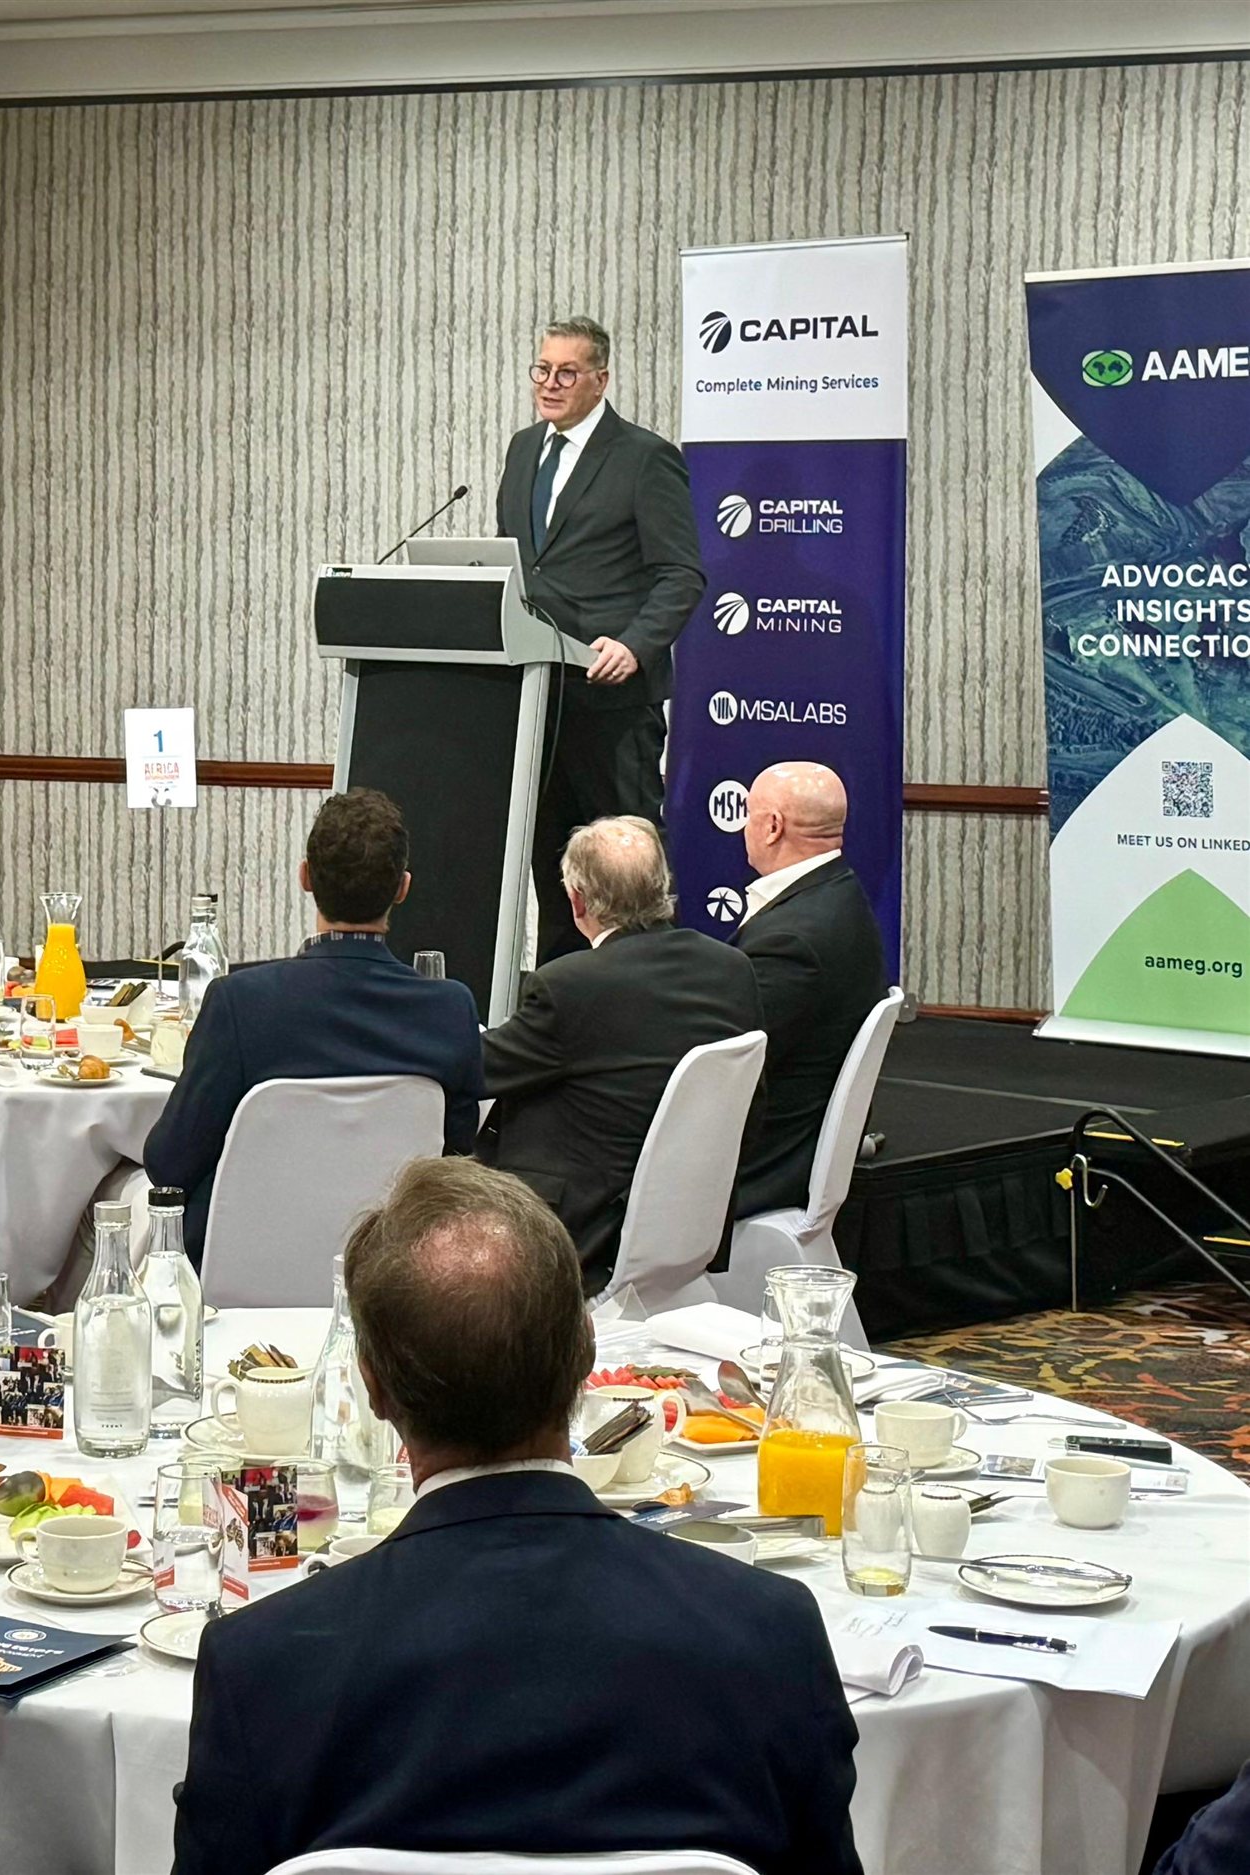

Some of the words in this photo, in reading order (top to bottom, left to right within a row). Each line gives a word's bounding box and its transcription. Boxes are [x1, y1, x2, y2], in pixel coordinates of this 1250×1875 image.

[739, 315, 879, 342] CAPITAL
[1141, 346, 1250, 381] AAME
[695, 378, 762, 395] Complete
[766, 376, 818, 393] Mining
[822, 374, 879, 391] Services
[758, 499, 843, 516] CAPITAL
[758, 517, 843, 534] DRILLING
[1101, 563, 1250, 588] ADVOCAC
[756, 598, 842, 615] CAPITAL
[1116, 599, 1250, 623] INSIGHTS
[756, 617, 842, 633] MINING
[1076, 634, 1250, 658] CONNECTIO
[740, 700, 847, 725] MSALABS
[153, 730, 163, 752] 1
[713, 790, 748, 822] MSM
[1116, 833, 1151, 847] MEET
[1155, 836, 1173, 848] US
[1177, 836, 1197, 849] ON
[1201, 838, 1250, 851] LINKED
[1144, 954, 1243, 978] aameg.org
